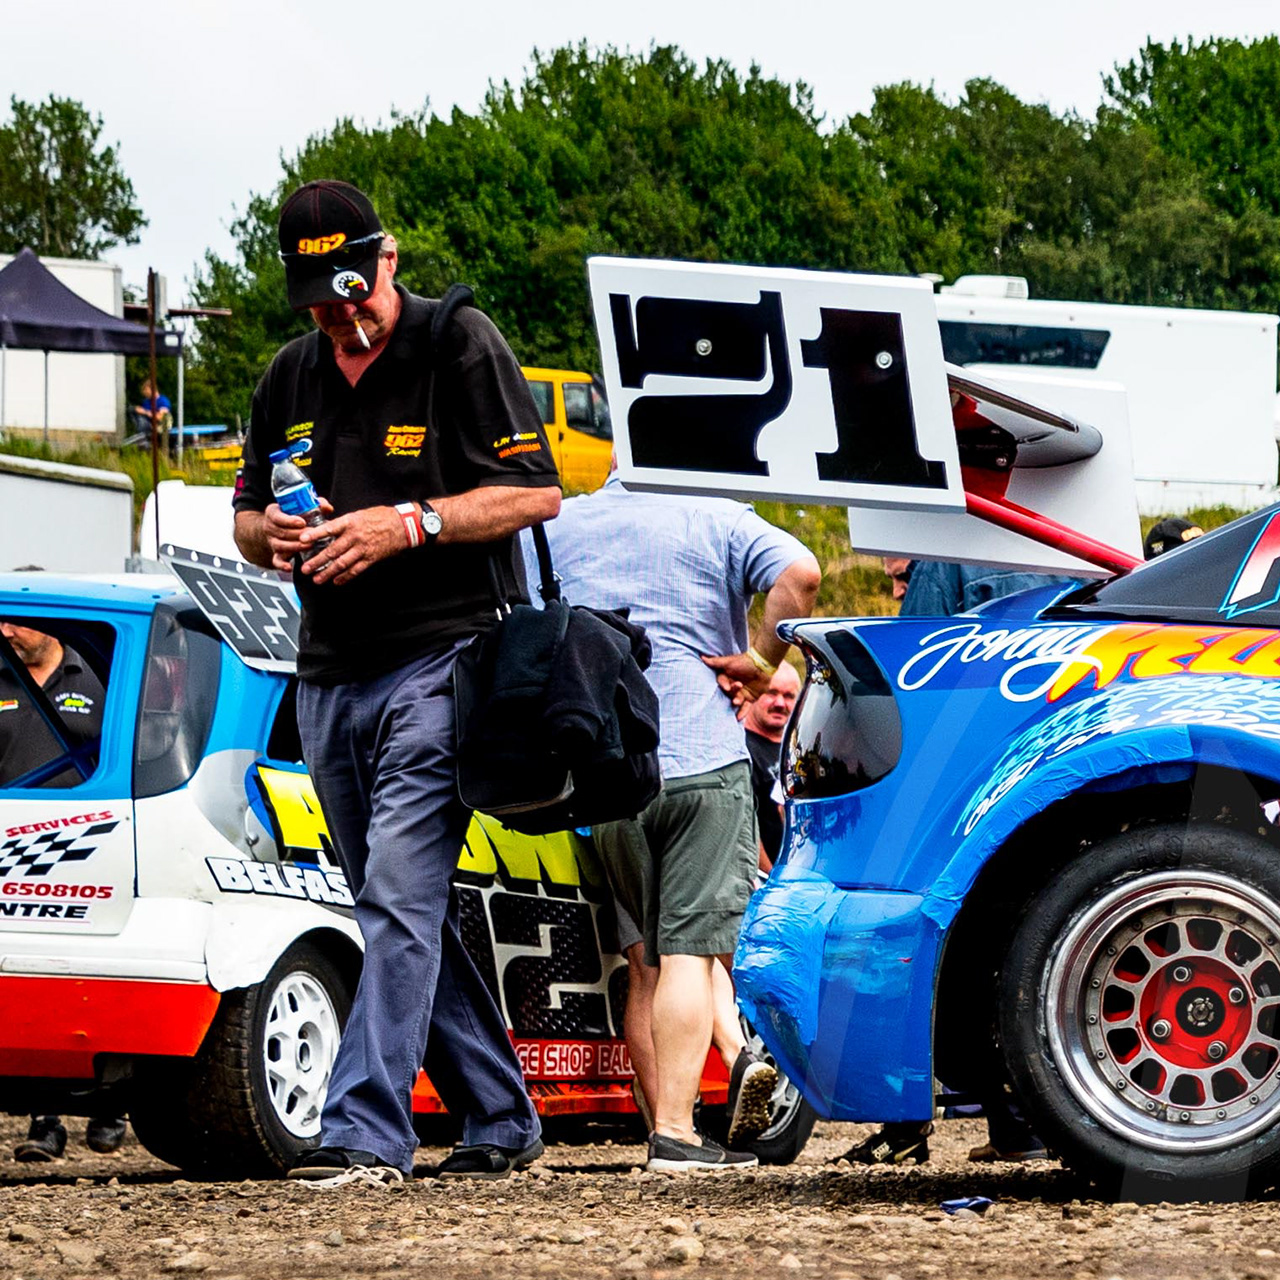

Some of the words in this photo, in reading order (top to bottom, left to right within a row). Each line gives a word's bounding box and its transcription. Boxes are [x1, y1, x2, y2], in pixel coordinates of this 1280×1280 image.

[297, 232, 347, 255] 962
[384, 433, 425, 448] 962
[898, 622, 1118, 703] Jonny
[5, 810, 114, 837] SERVICES
[2, 881, 114, 900] 6508105
[543, 1042, 595, 1077] SHOP
